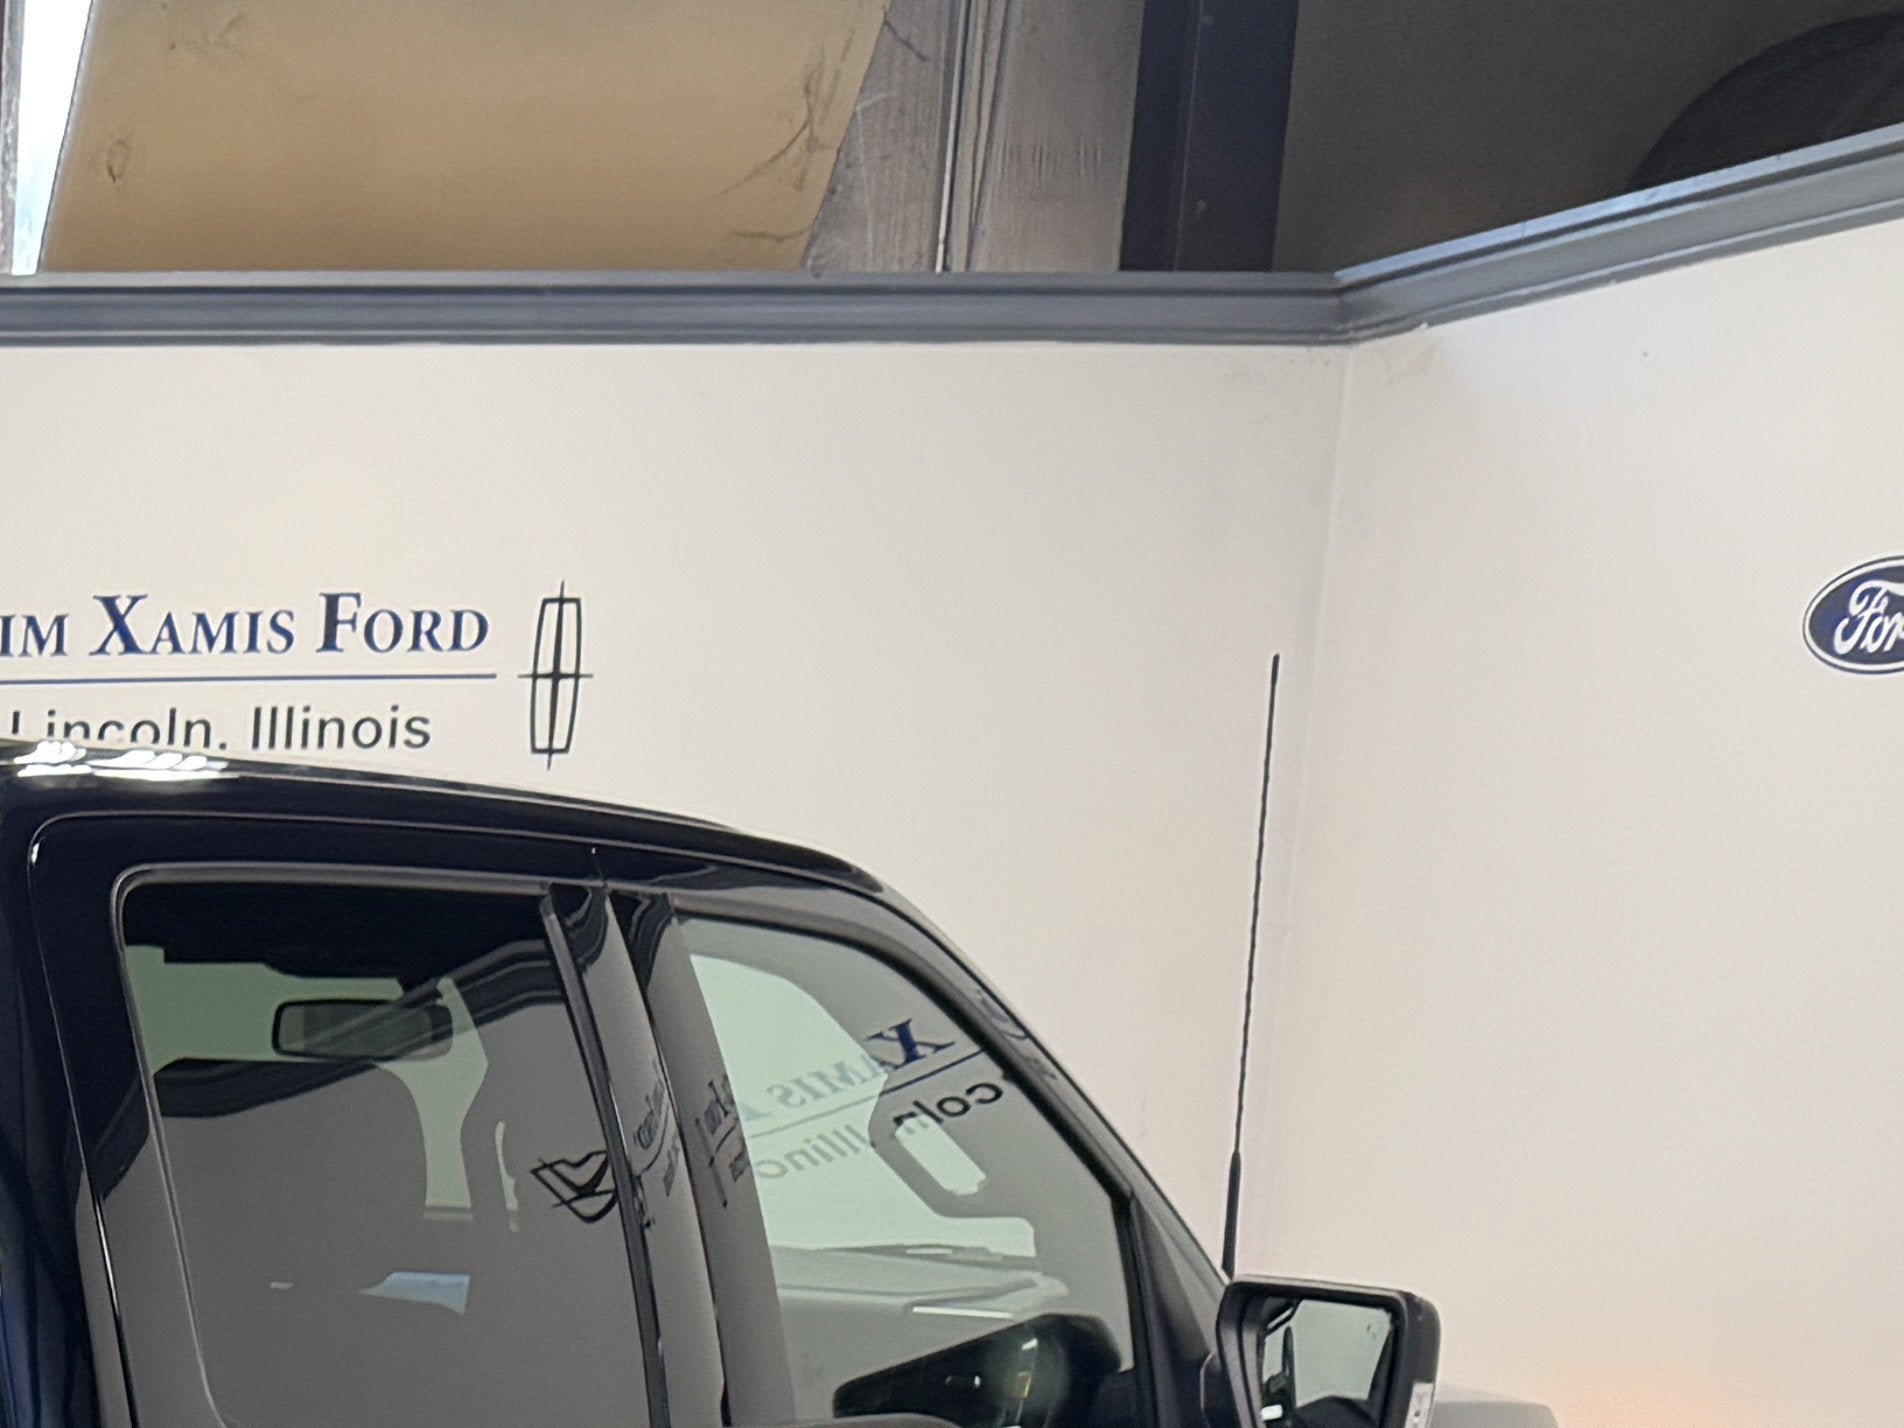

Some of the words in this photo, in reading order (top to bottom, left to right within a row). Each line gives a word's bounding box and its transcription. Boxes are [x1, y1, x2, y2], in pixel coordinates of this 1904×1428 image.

[91, 593, 295, 656] XAMIS
[316, 592, 490, 654] FORD
[1834, 579, 1904, 655] For
[250, 704, 432, 751] Illinois
